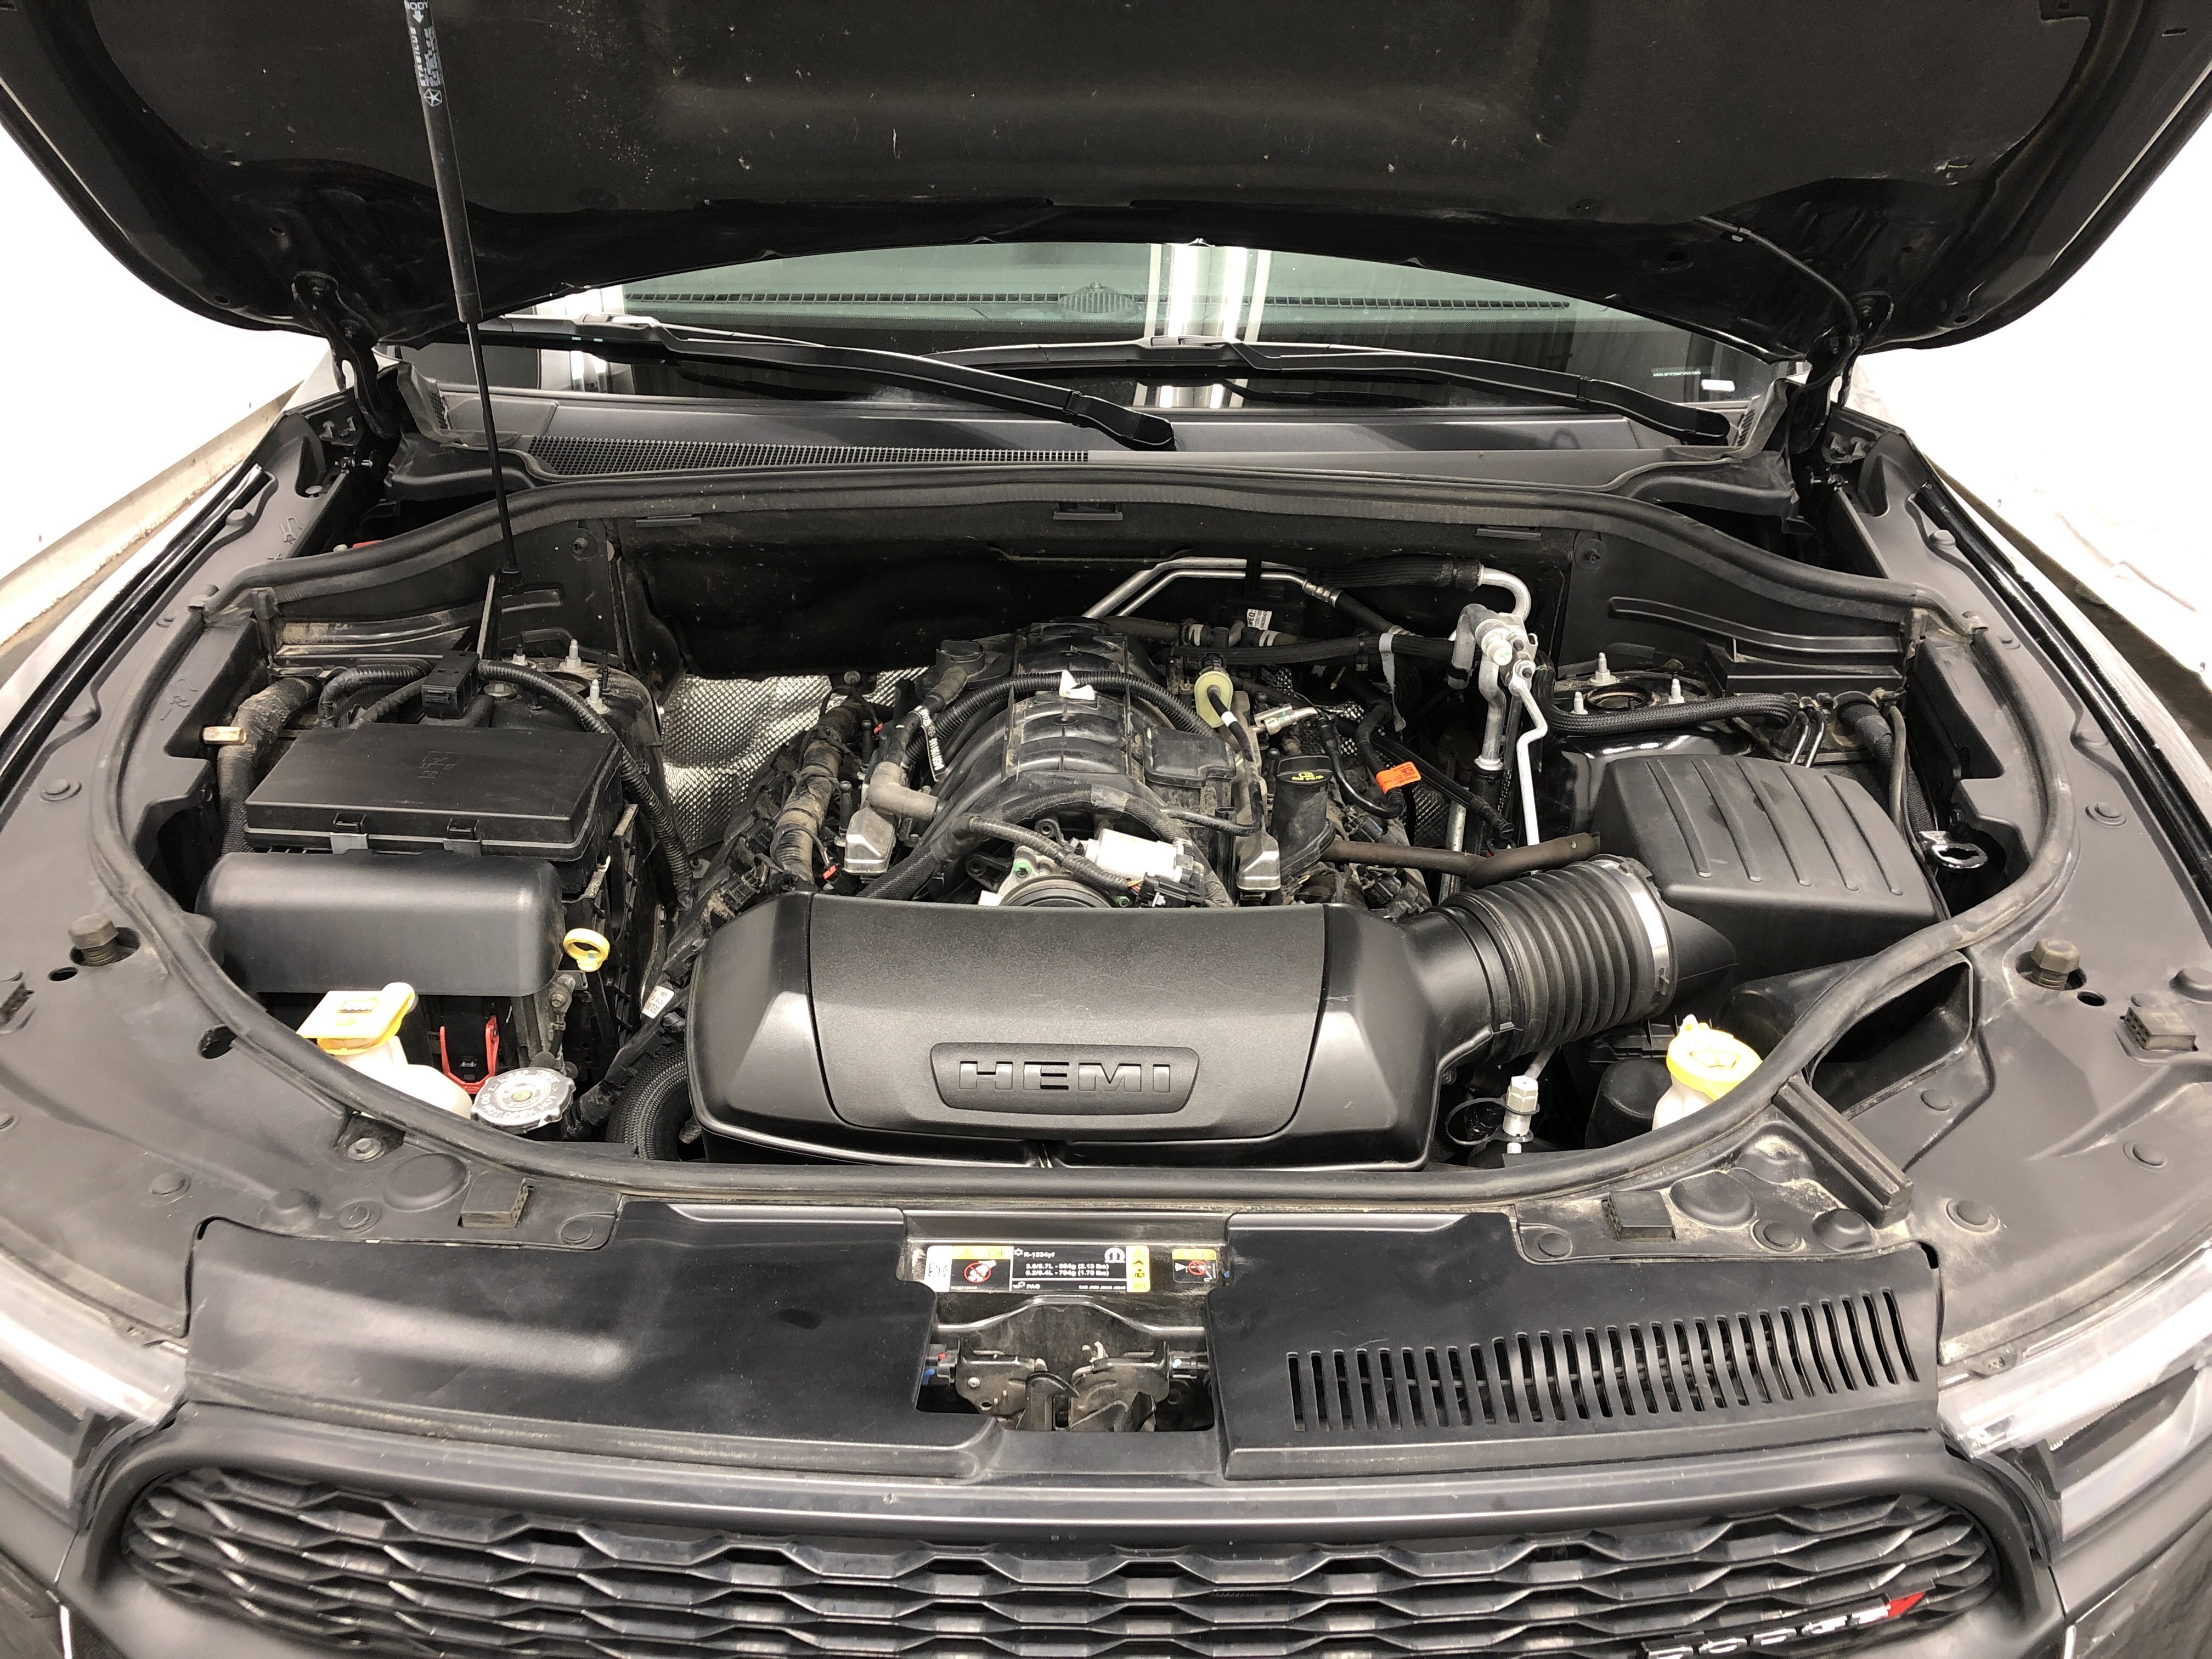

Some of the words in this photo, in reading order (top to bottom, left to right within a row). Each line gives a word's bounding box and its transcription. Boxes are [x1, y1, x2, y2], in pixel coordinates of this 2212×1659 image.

[404, 2, 428, 10] BODY
[959, 1060, 1171, 1093] HEMI
[483, 1103, 504, 1117] NOT
[503, 1109, 537, 1119] OPEN
